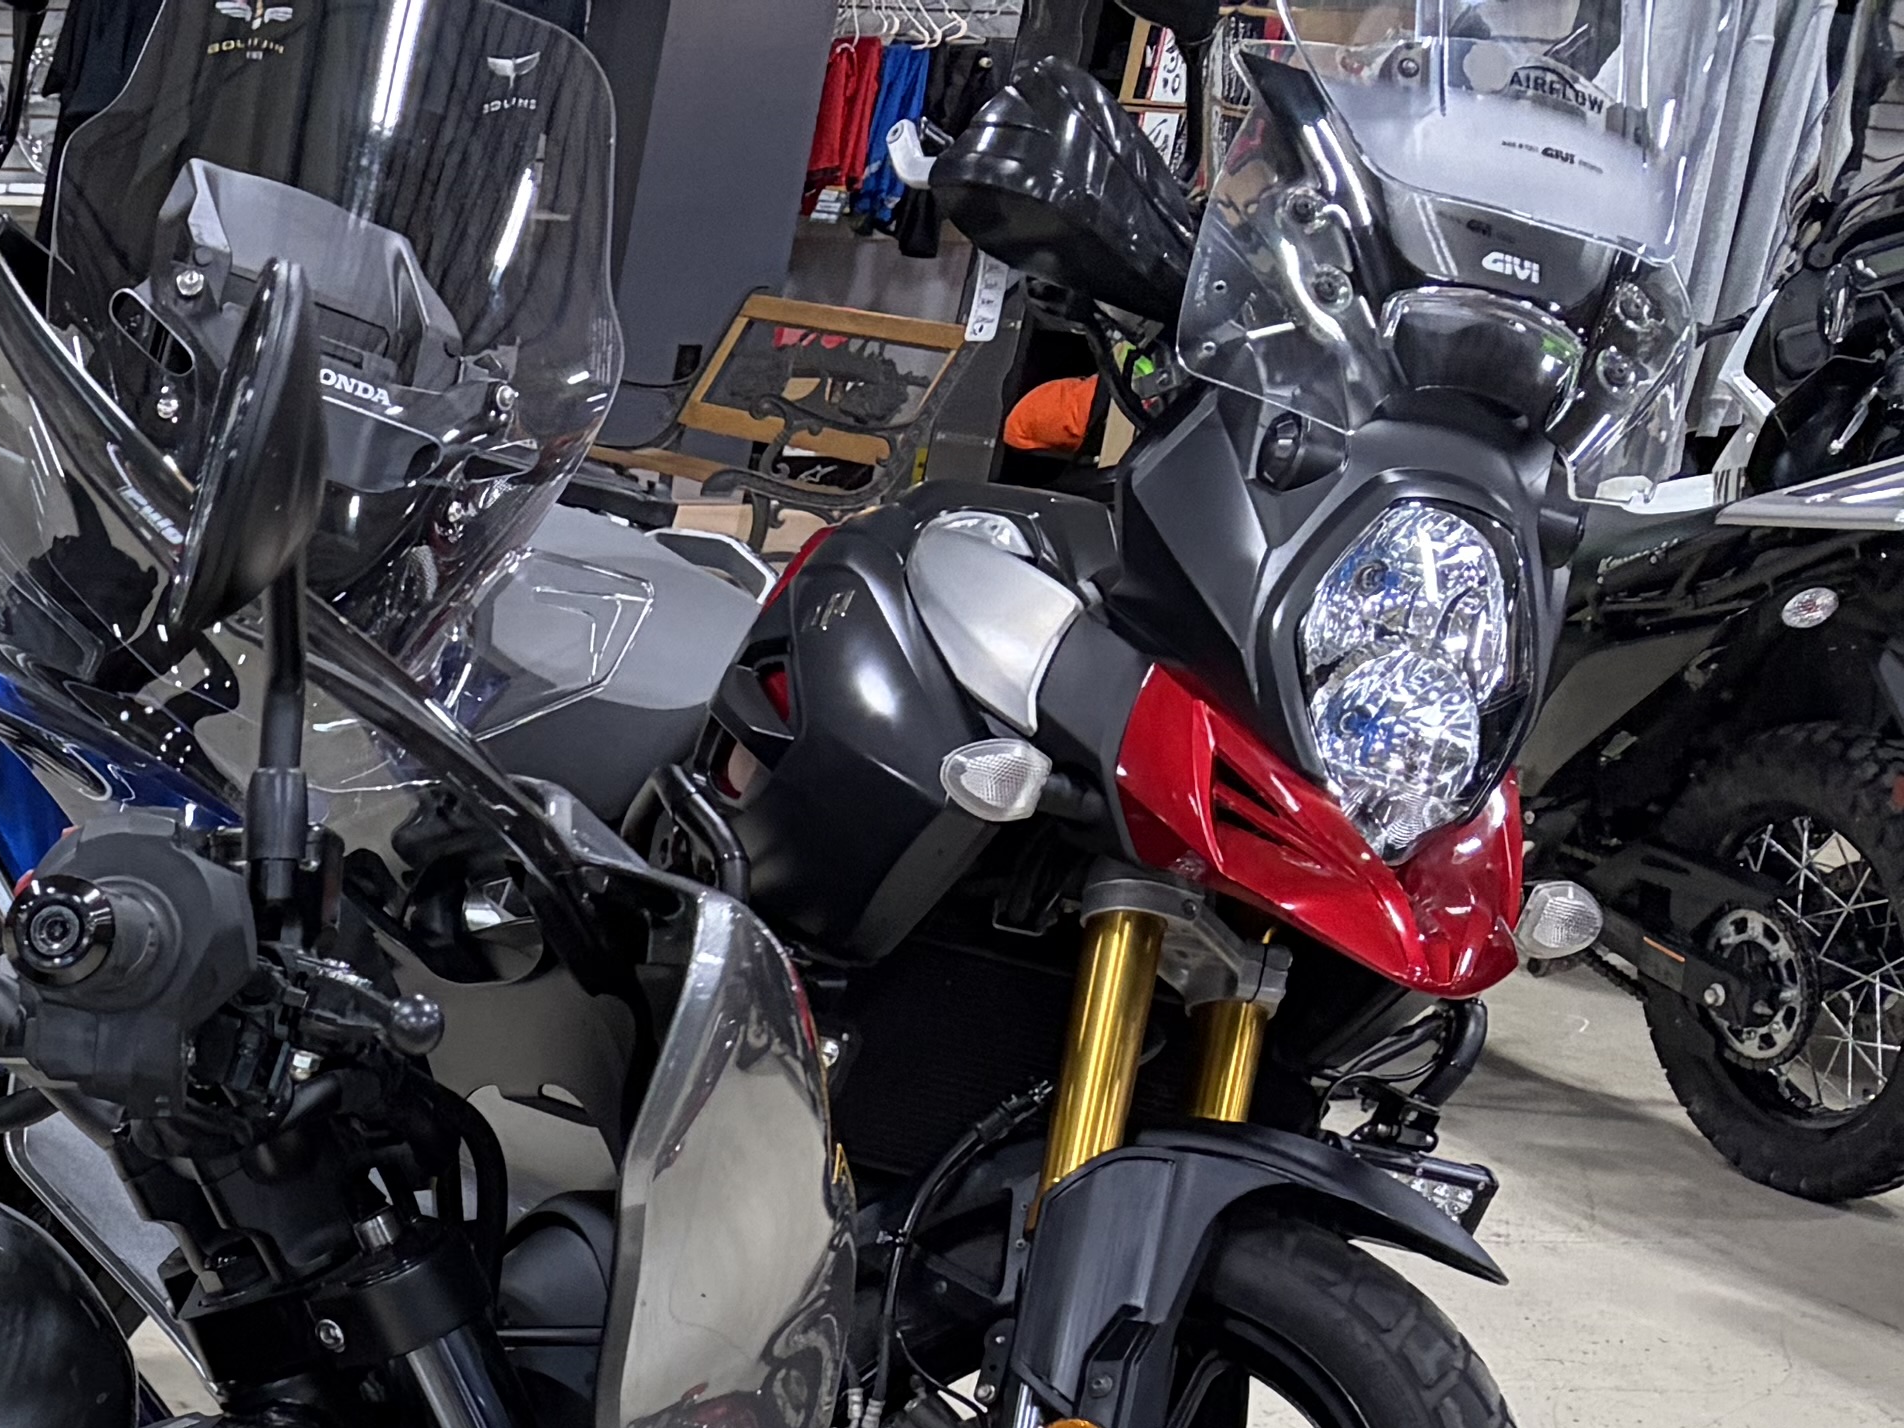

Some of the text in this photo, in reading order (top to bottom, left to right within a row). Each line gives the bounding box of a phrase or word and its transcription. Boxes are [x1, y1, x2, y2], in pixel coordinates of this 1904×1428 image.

[1509, 71, 1605, 115] AIRFLOW
[1481, 251, 1541, 285] GIVI
[319, 367, 392, 407] ONDA
